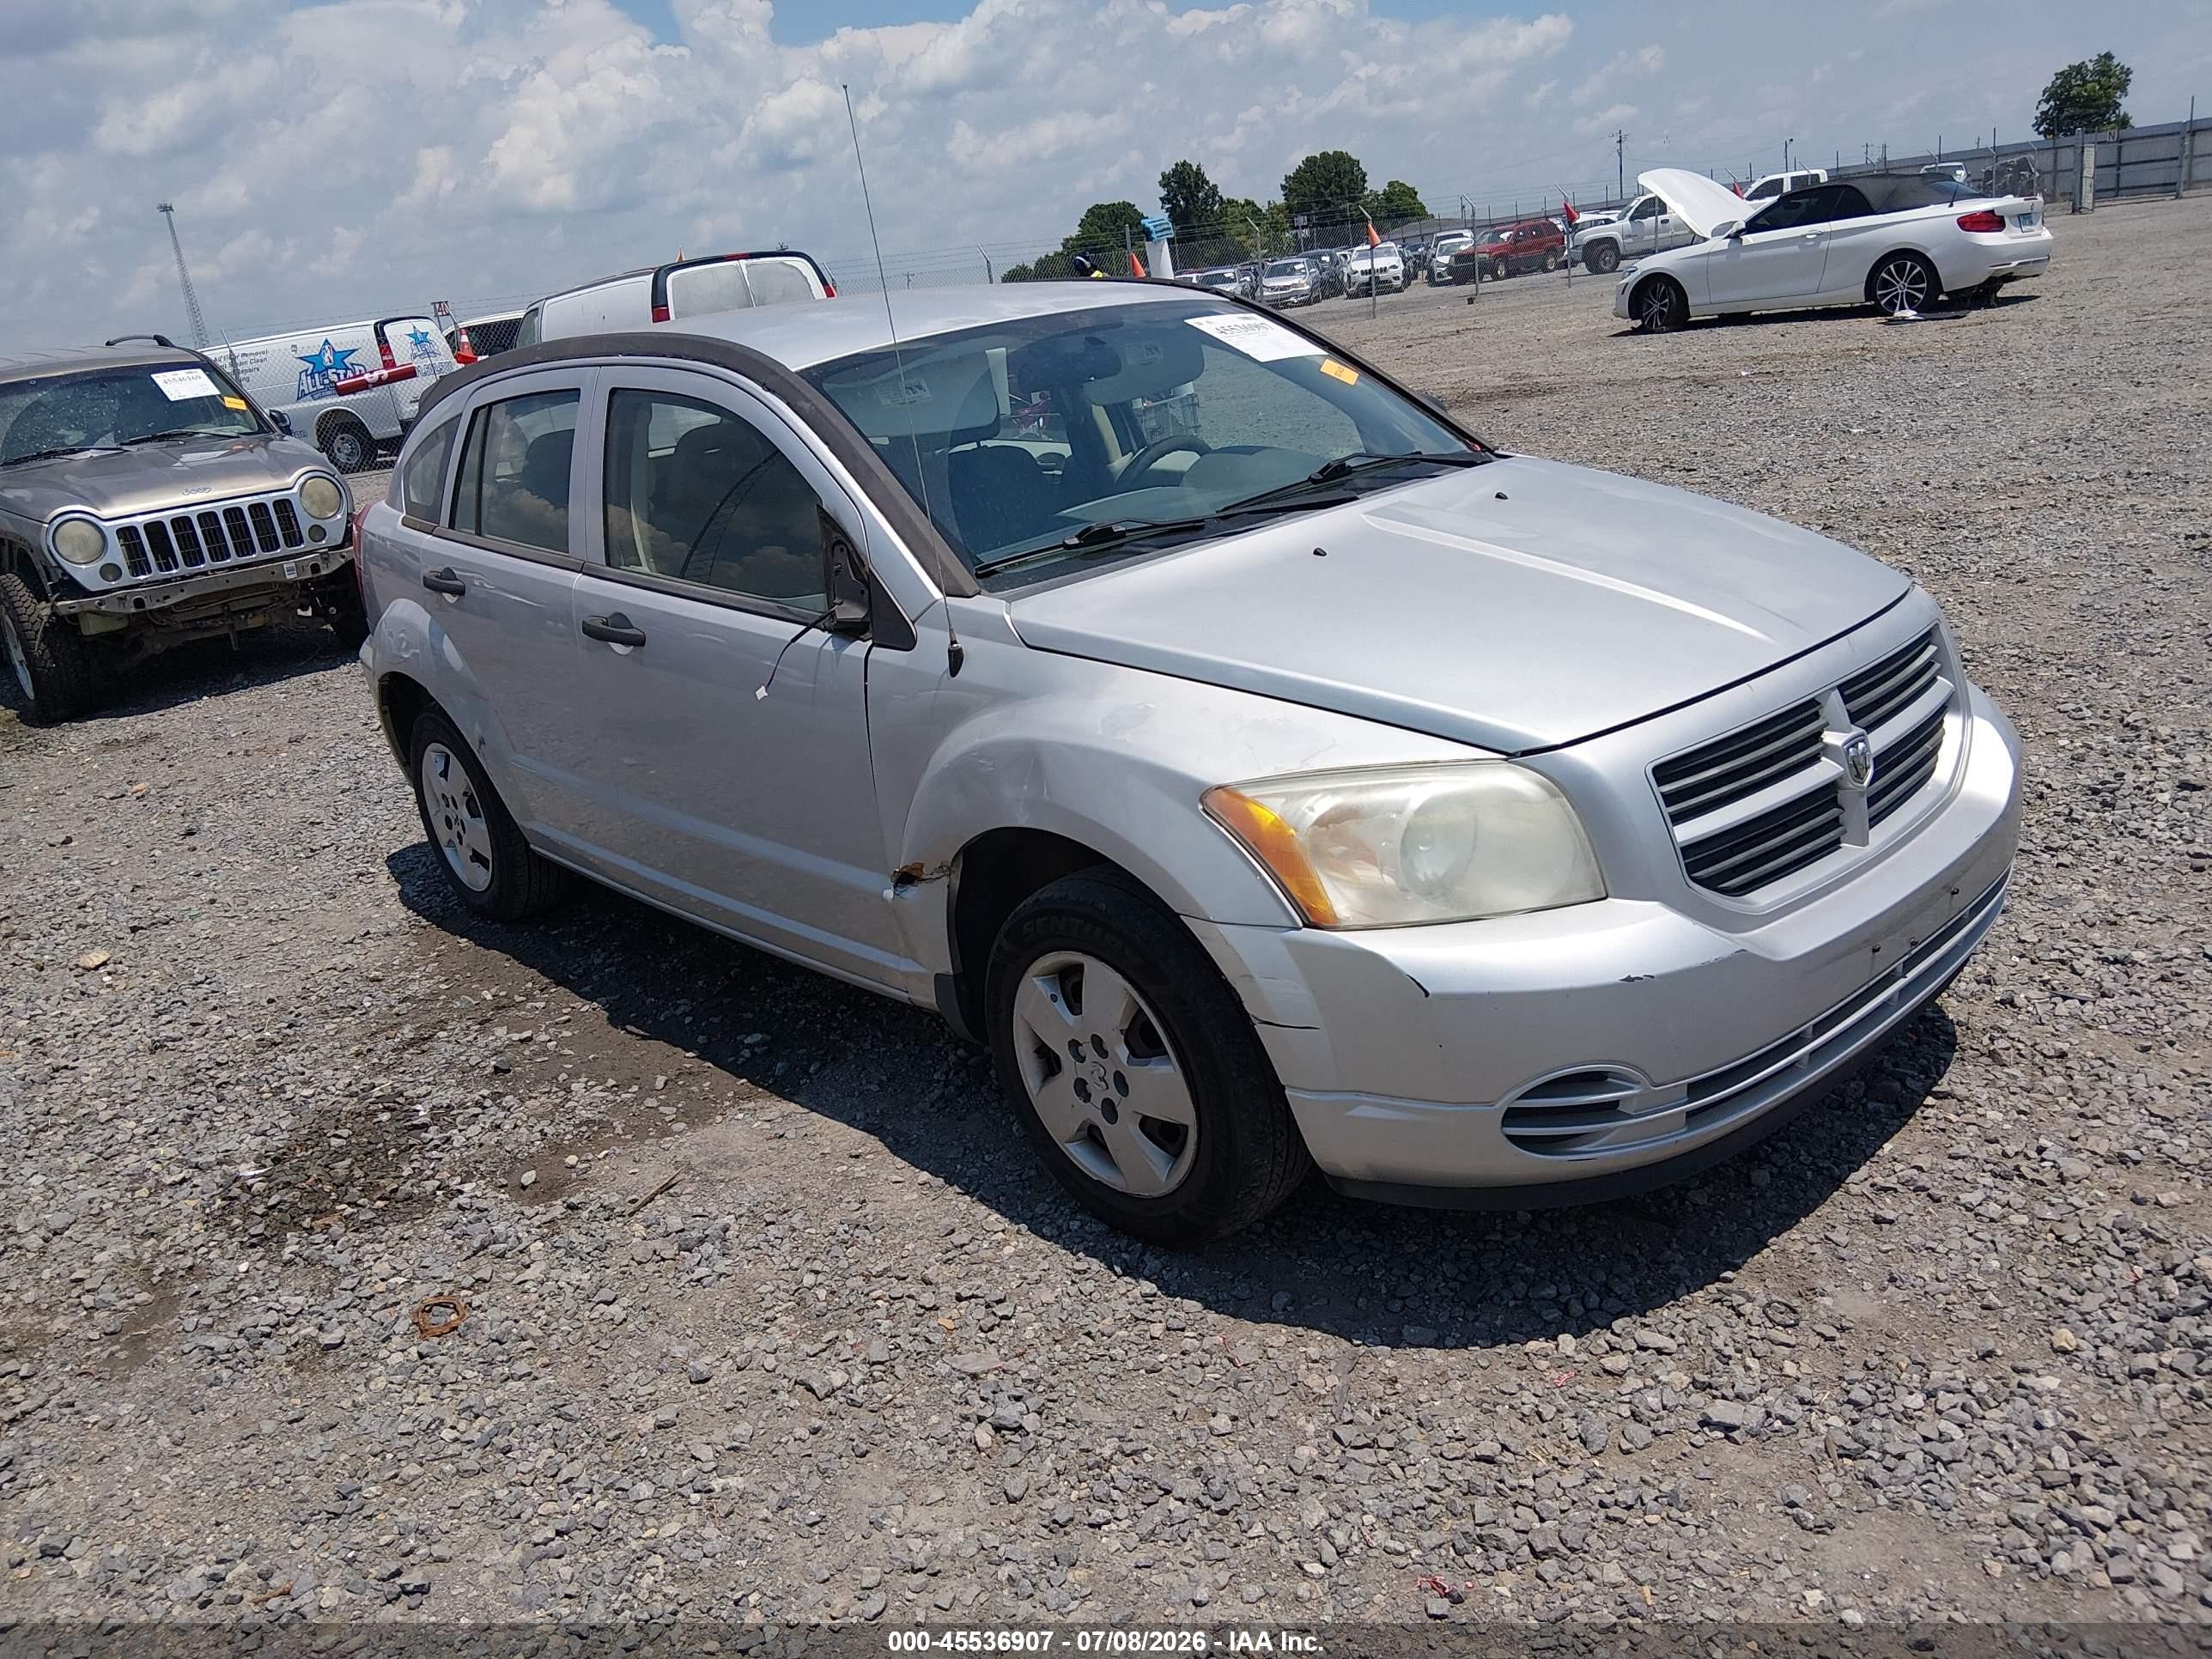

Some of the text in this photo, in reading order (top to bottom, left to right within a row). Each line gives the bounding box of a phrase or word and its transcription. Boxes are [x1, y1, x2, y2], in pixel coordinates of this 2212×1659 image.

[241, 349, 268, 358] Removal
[249, 356, 268, 365] Clean
[181, 486, 212, 496] Jeep
